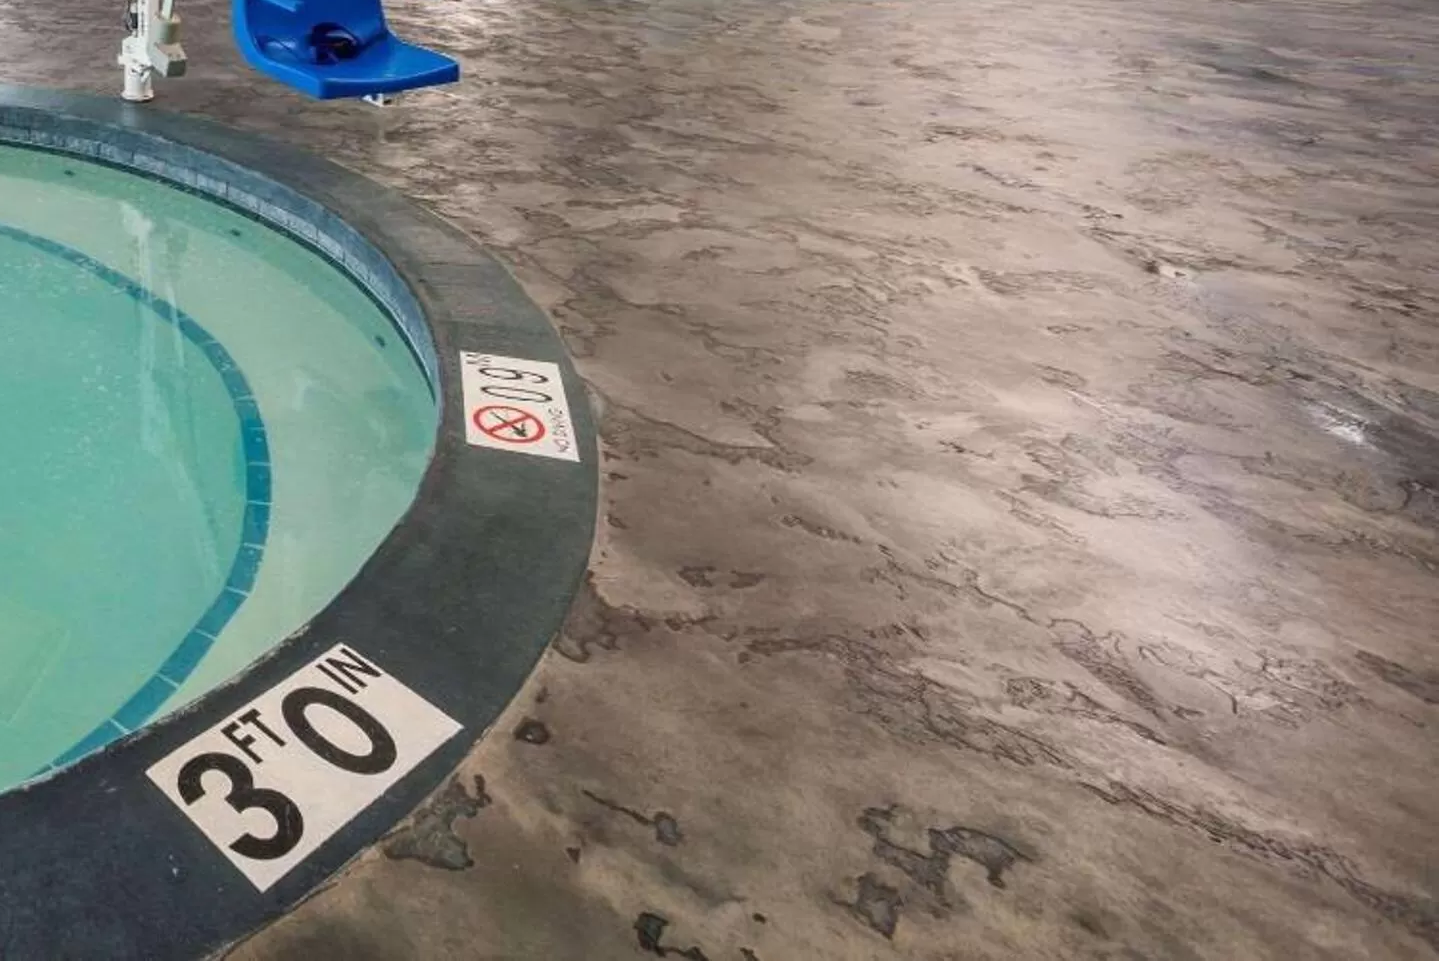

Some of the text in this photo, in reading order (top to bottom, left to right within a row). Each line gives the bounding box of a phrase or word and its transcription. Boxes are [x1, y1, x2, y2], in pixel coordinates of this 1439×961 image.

[315, 648, 383, 695] IN
[221, 708, 286, 764] FT
[177, 752, 304, 860] 3
